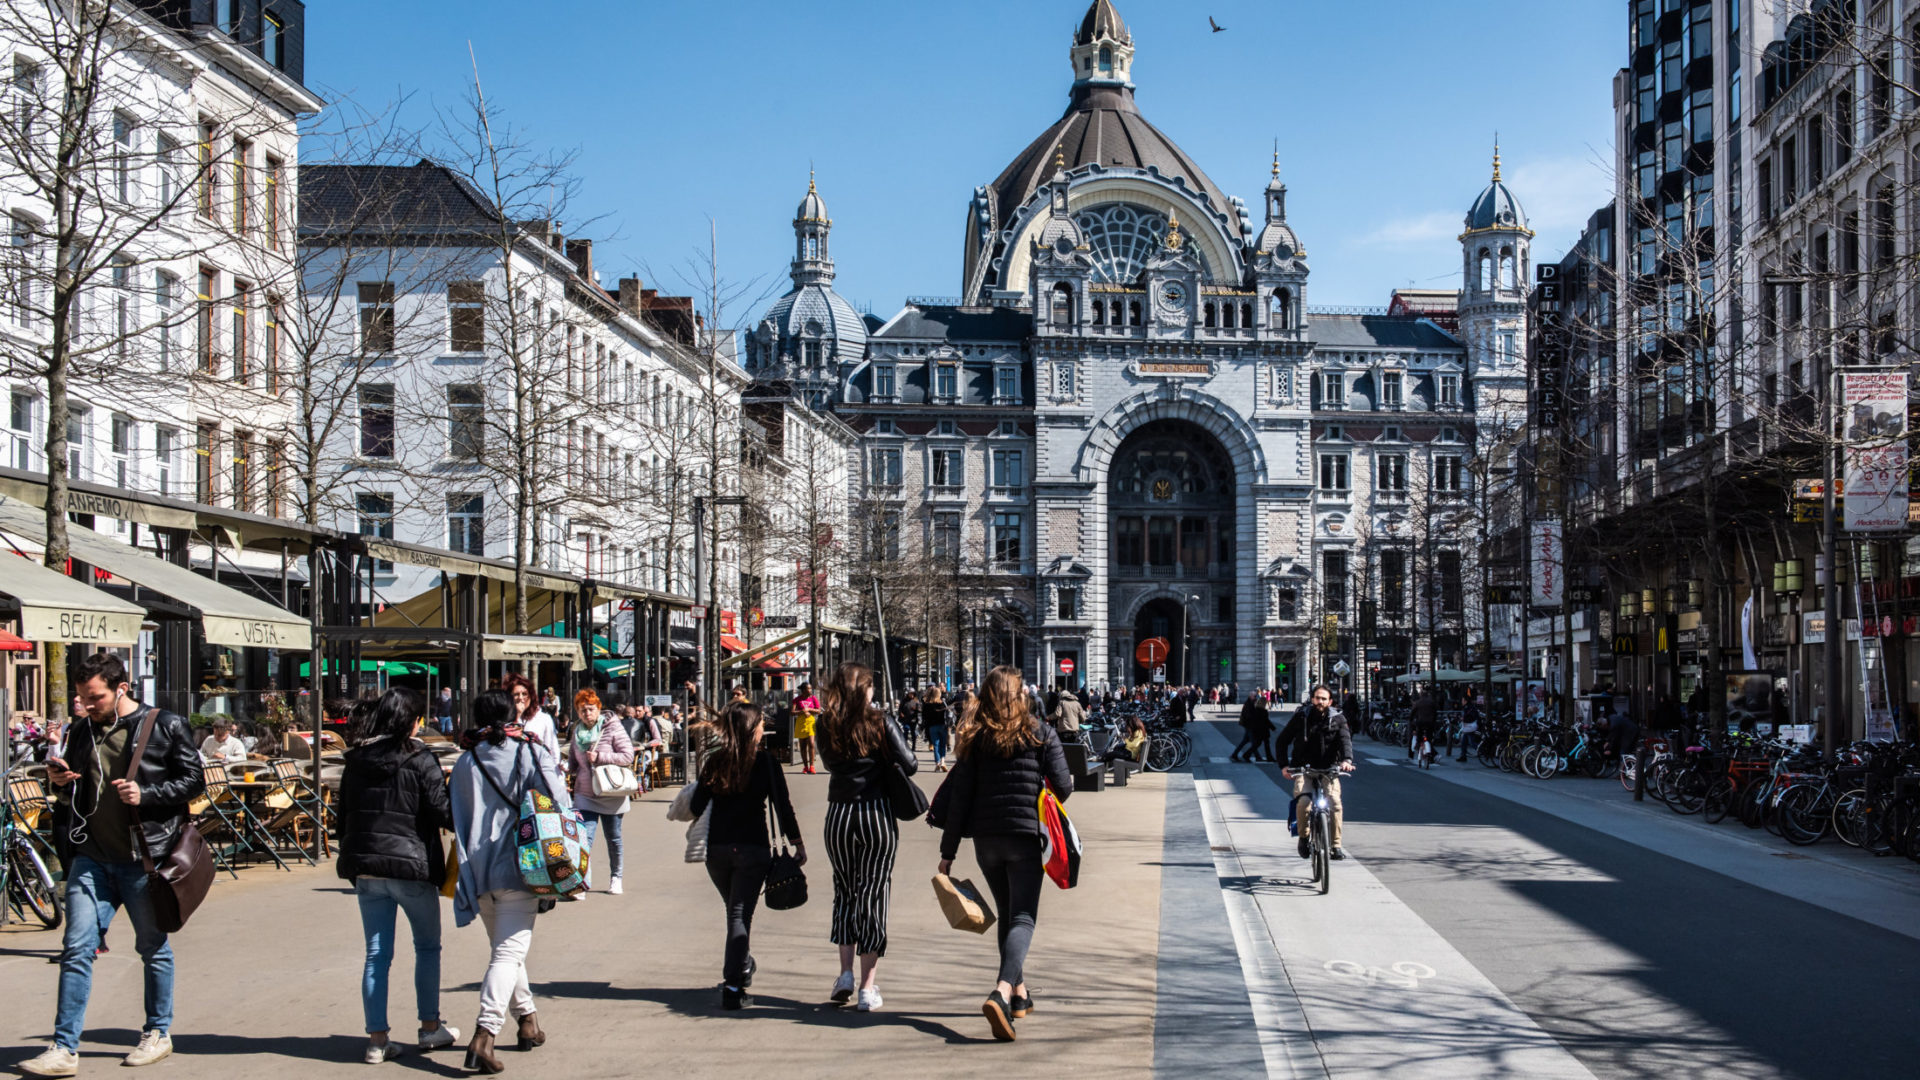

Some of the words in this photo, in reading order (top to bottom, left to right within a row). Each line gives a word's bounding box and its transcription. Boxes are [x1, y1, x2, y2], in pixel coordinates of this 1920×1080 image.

[67, 492, 121, 517] ANREMO
[60, 612, 107, 639] BELLA
[242, 621, 279, 644] VISTA
